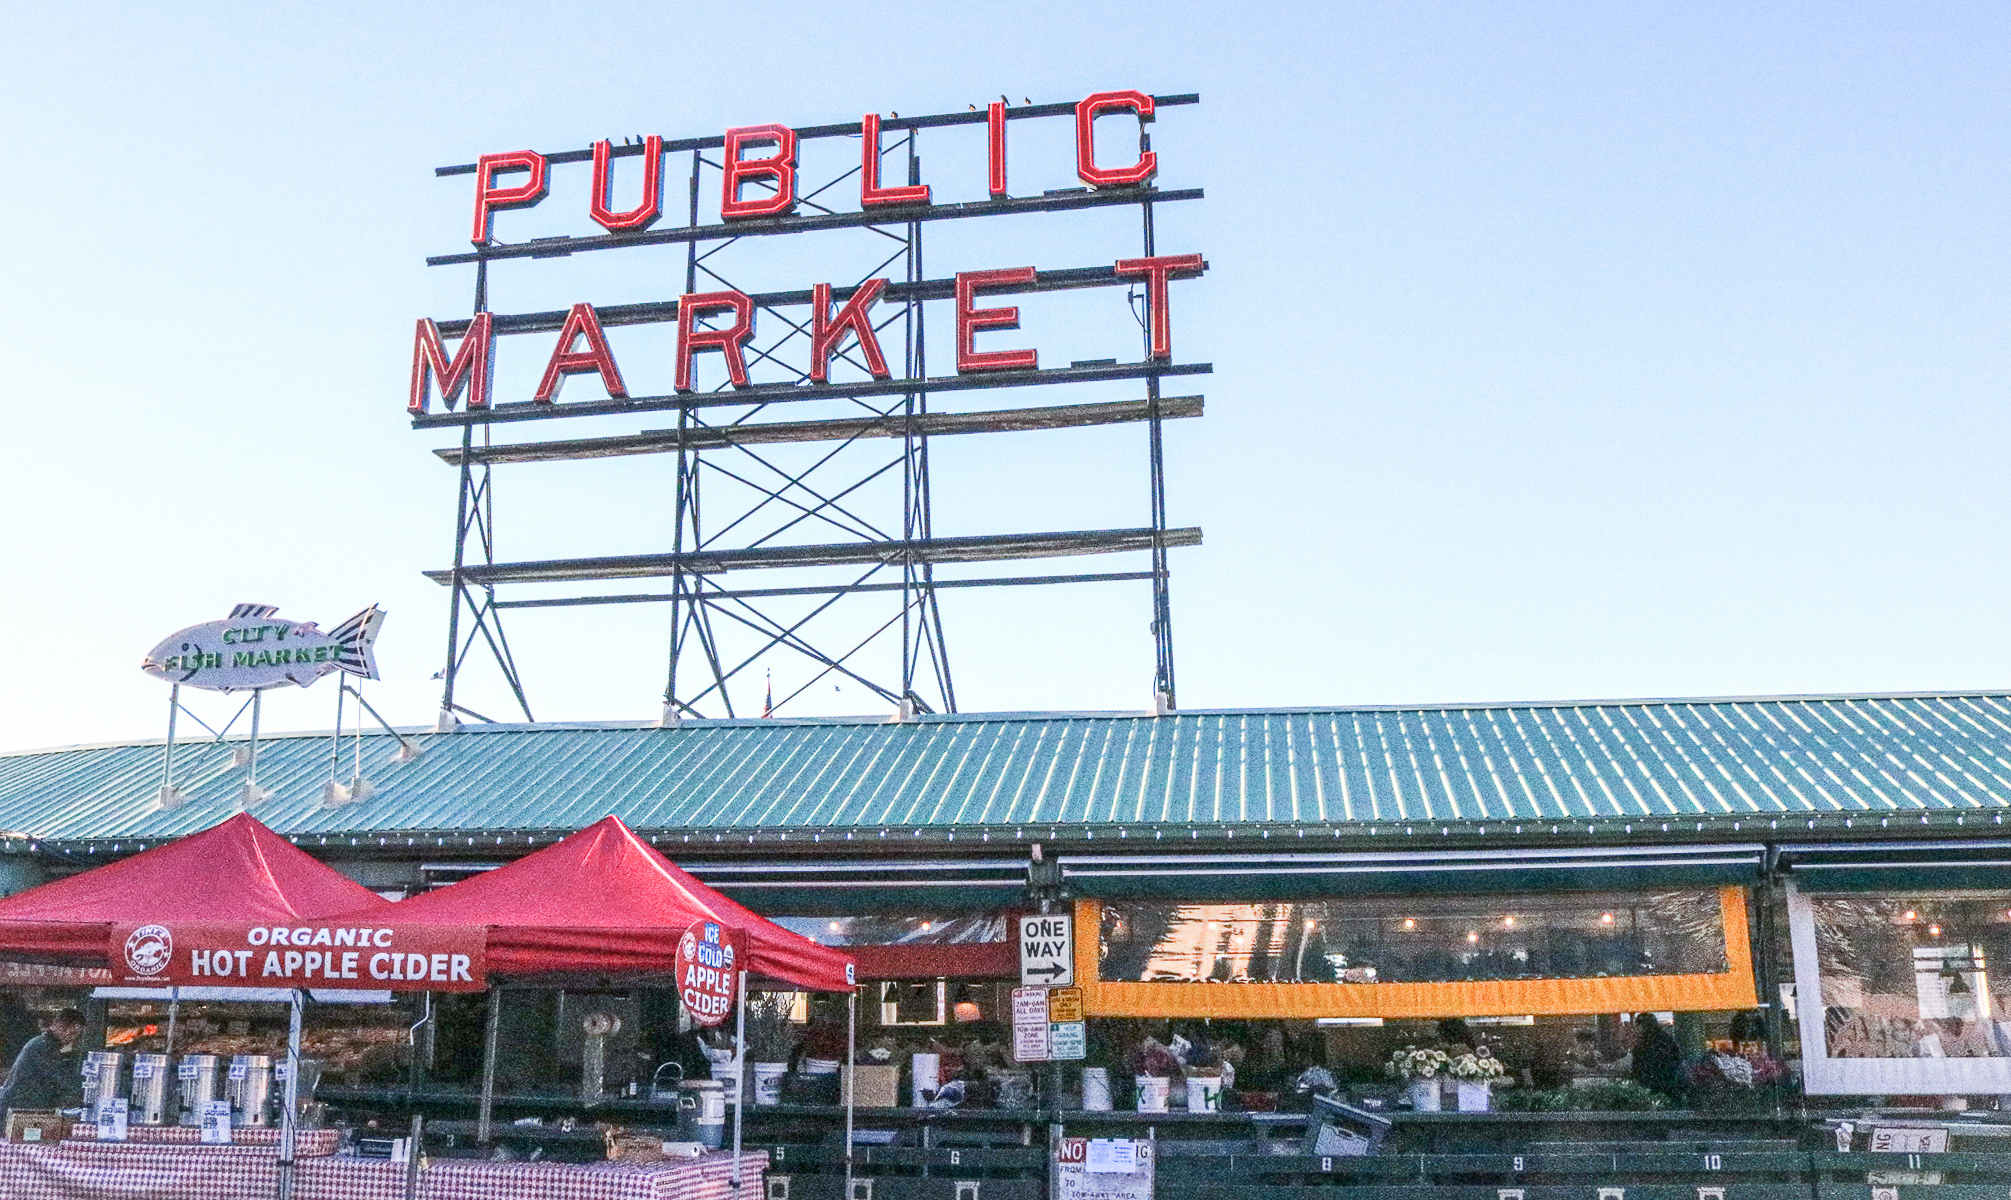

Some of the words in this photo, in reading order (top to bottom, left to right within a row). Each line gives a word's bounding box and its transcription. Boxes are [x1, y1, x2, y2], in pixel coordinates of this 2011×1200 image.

[471, 89, 1159, 246] PUBLIC
[407, 252, 1204, 416] MARKET
[222, 624, 289, 645] CITY
[163, 652, 222, 672] FISH
[232, 644, 345, 669] MARKET
[248, 926, 394, 948] ORGANIC
[705, 925, 720, 945] ICE
[1025, 920, 1065, 938] ONE
[698, 943, 723, 969] COLD
[1025, 941, 1065, 958] WAY
[130, 960, 165, 973] ORGANIC
[192, 949, 253, 977] HOT
[262, 950, 358, 979] APPLE
[369, 952, 474, 982] CIDER
[685, 964, 731, 995] APPLE
[684, 988, 729, 1015] CIDER
[1061, 1142, 1083, 1160] NO
[1060, 1165, 1082, 1173] FROM
[1322, 1157, 1332, 1171] 8
[1513, 1156, 1524, 1171] 9
[1704, 1155, 1722, 1170] 10
[1908, 1153, 1921, 1169] 11
[1065, 1179, 1076, 1187] TO
